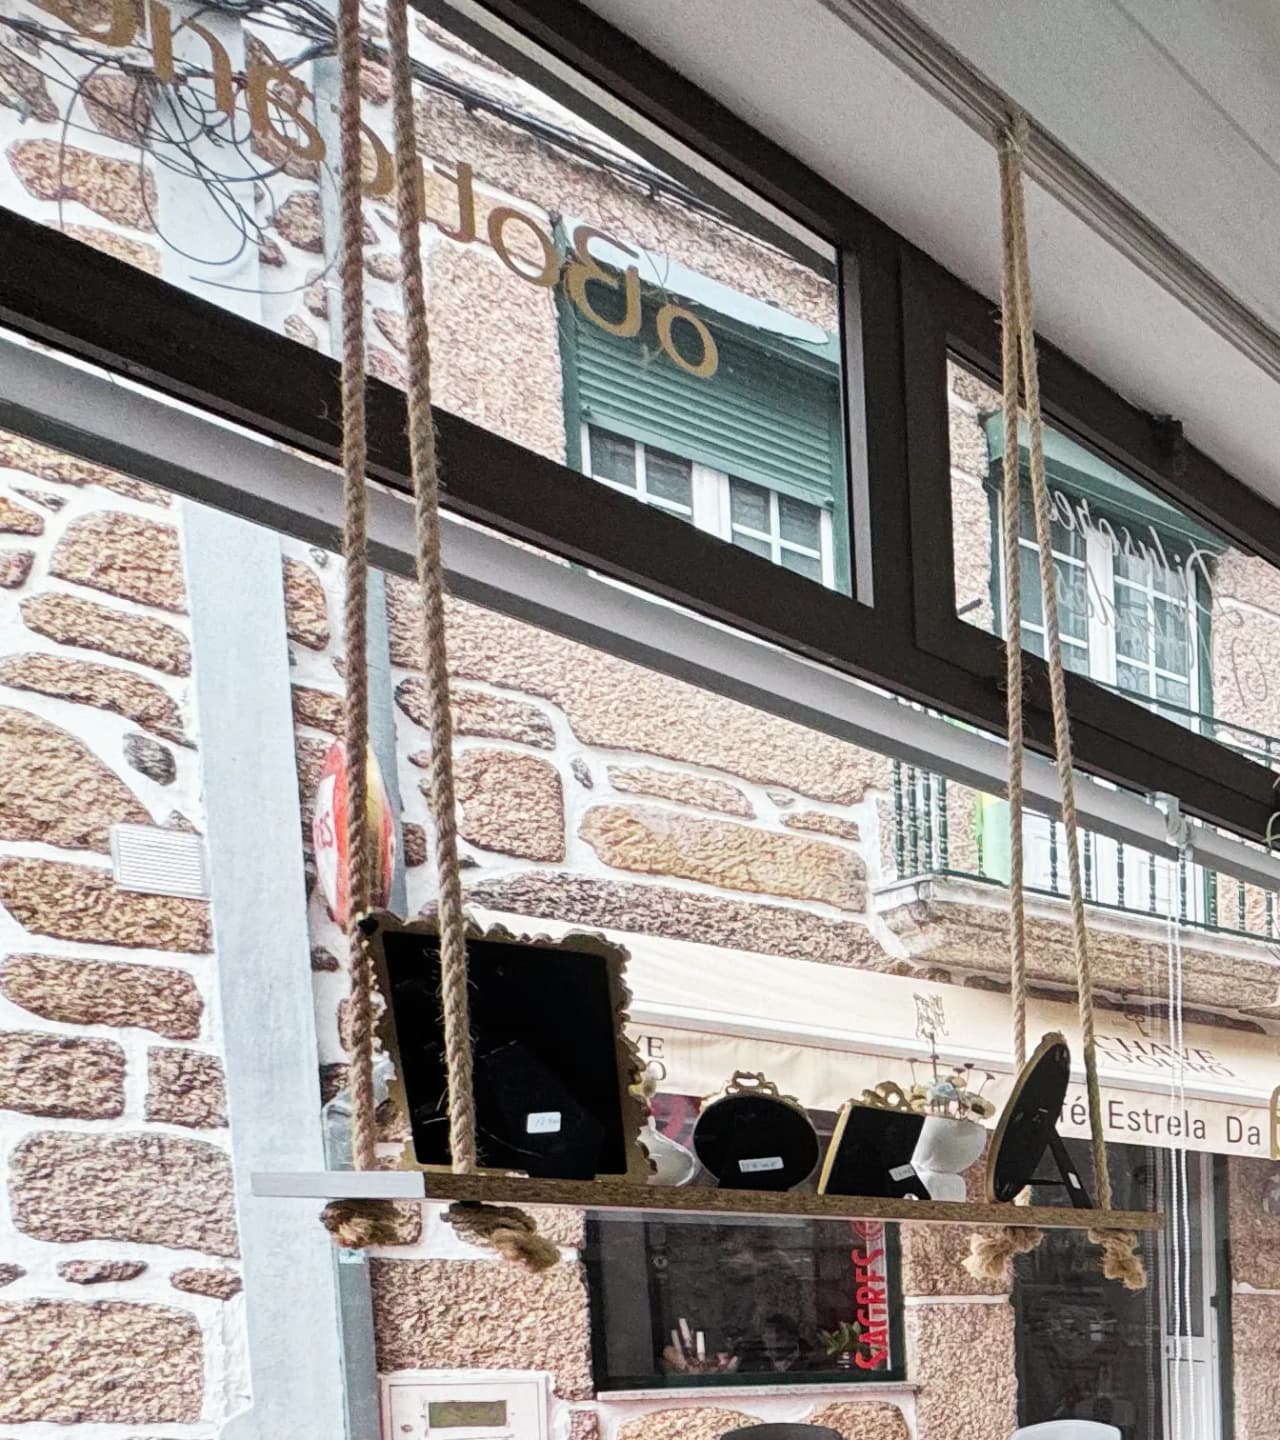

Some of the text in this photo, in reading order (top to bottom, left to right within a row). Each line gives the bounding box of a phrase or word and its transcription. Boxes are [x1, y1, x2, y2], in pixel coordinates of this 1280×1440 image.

[1092, 1034, 1216, 1064] CHAVE
[1107, 1100, 1207, 1141] Estrela
[1226, 1115, 1261, 1147] Da
